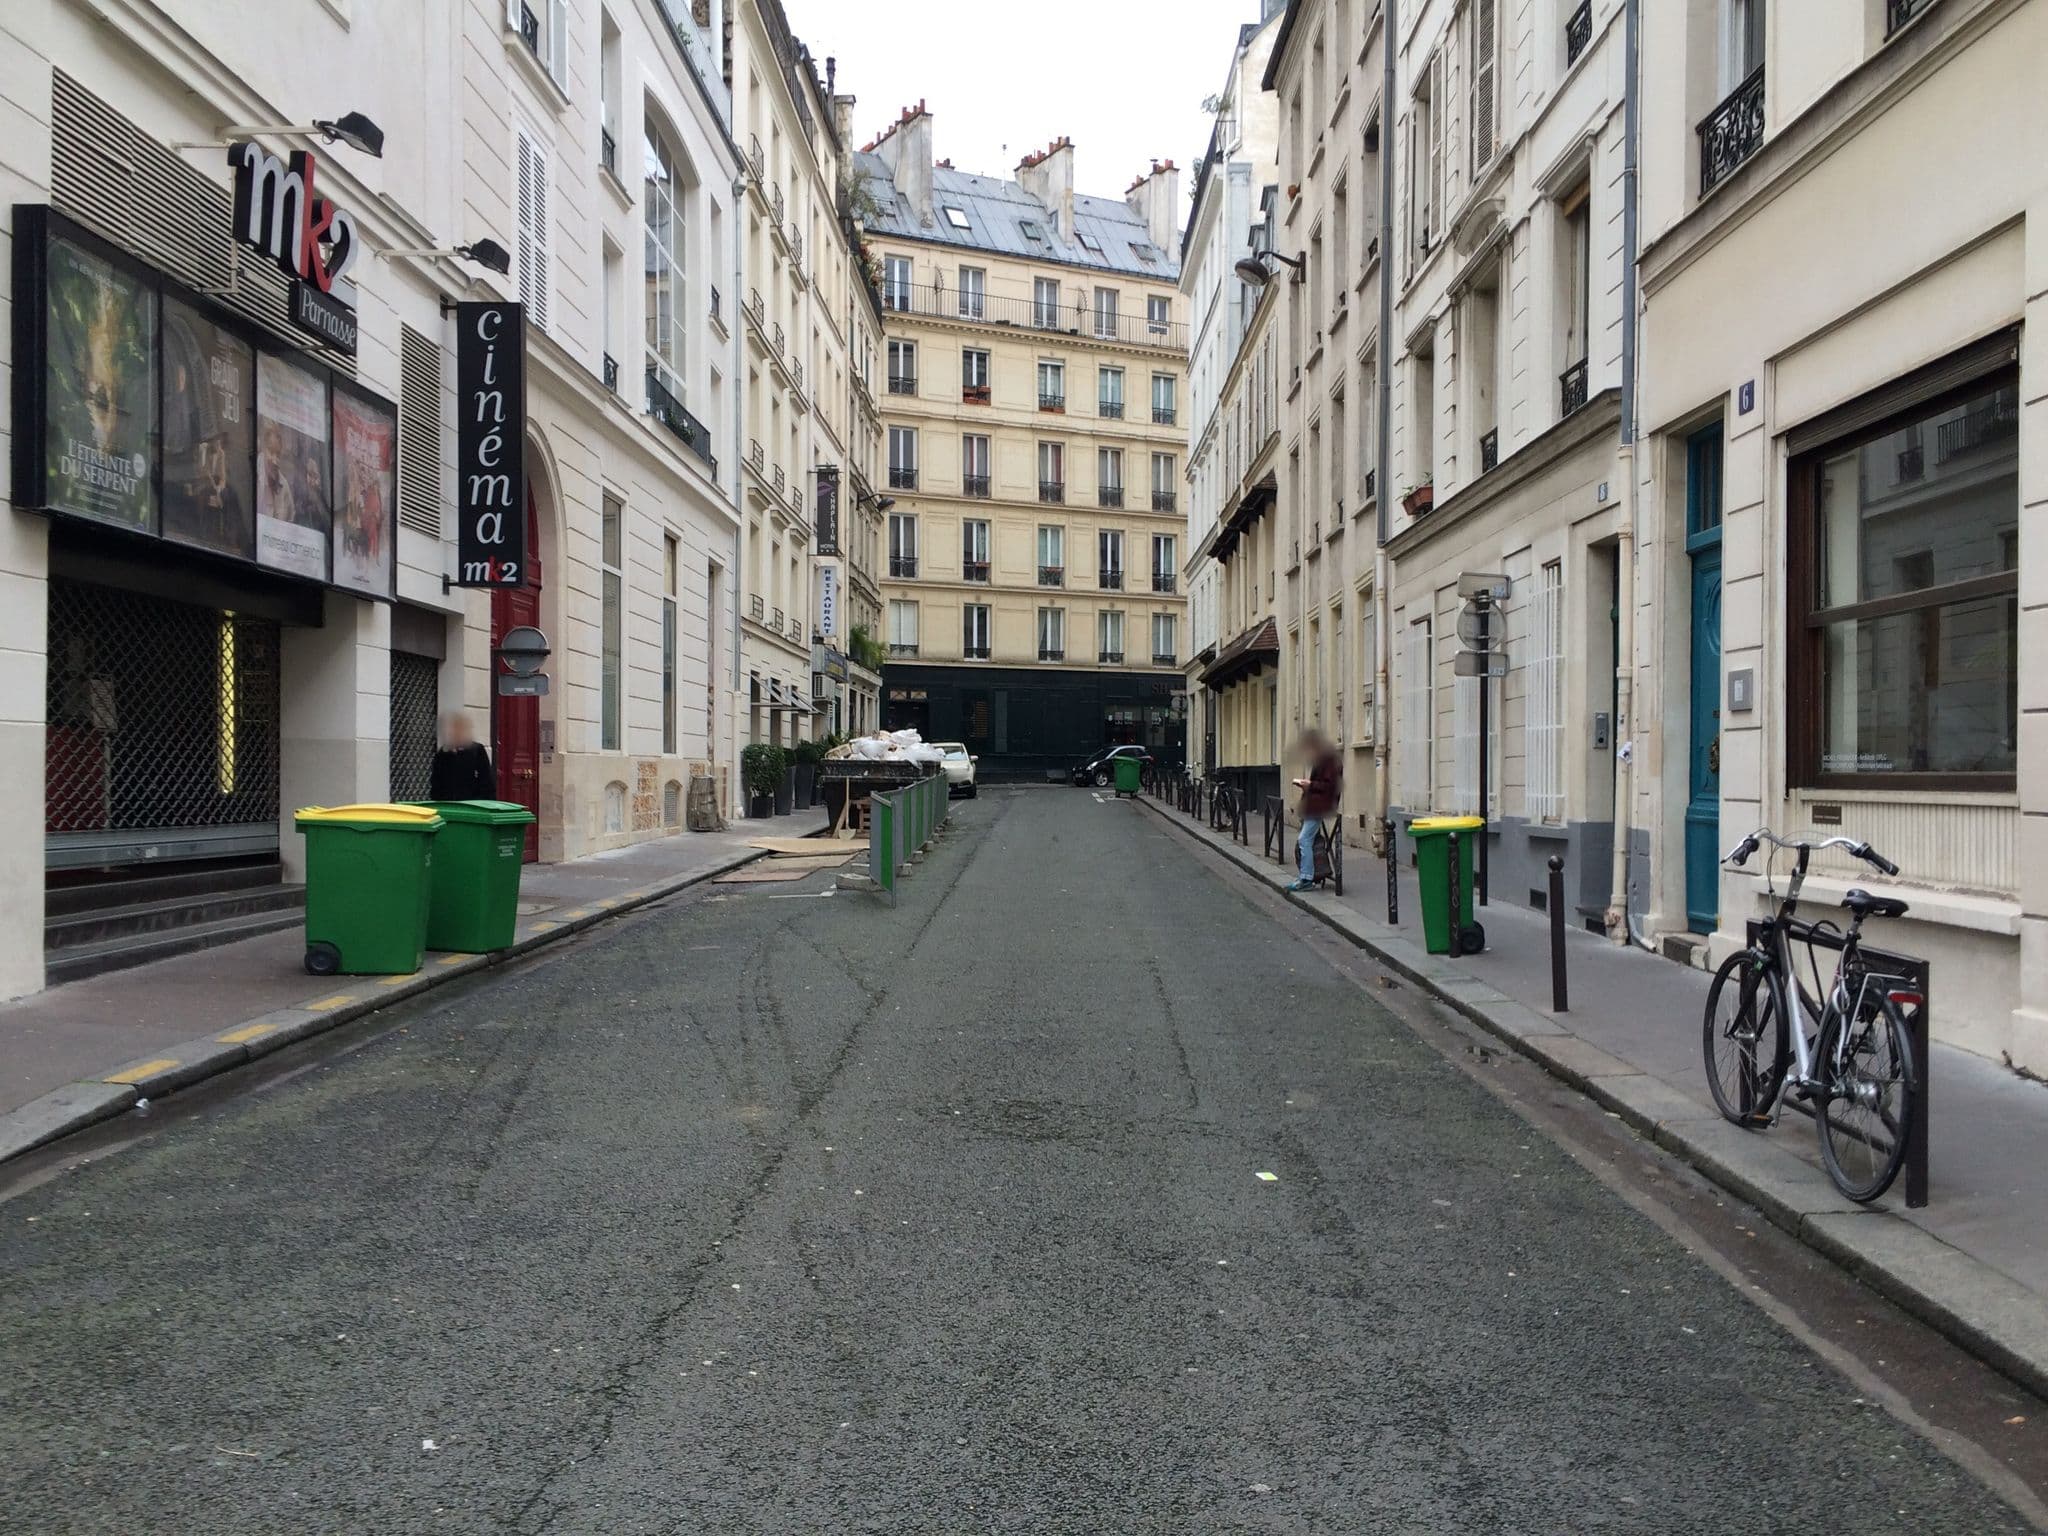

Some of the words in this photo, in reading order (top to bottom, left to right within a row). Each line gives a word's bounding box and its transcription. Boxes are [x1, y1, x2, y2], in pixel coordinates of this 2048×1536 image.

[243, 142, 358, 312] mk2
[301, 285, 357, 348] Parnasse
[1742, 384, 1750, 411] 6
[467, 309, 514, 545] cinéma
[60, 455, 82, 478] DU
[83, 463, 139, 497] SERPENT
[828, 474, 837, 482] LE
[463, 555, 519, 583] mk2
[823, 569, 832, 634] RESTAURANT
